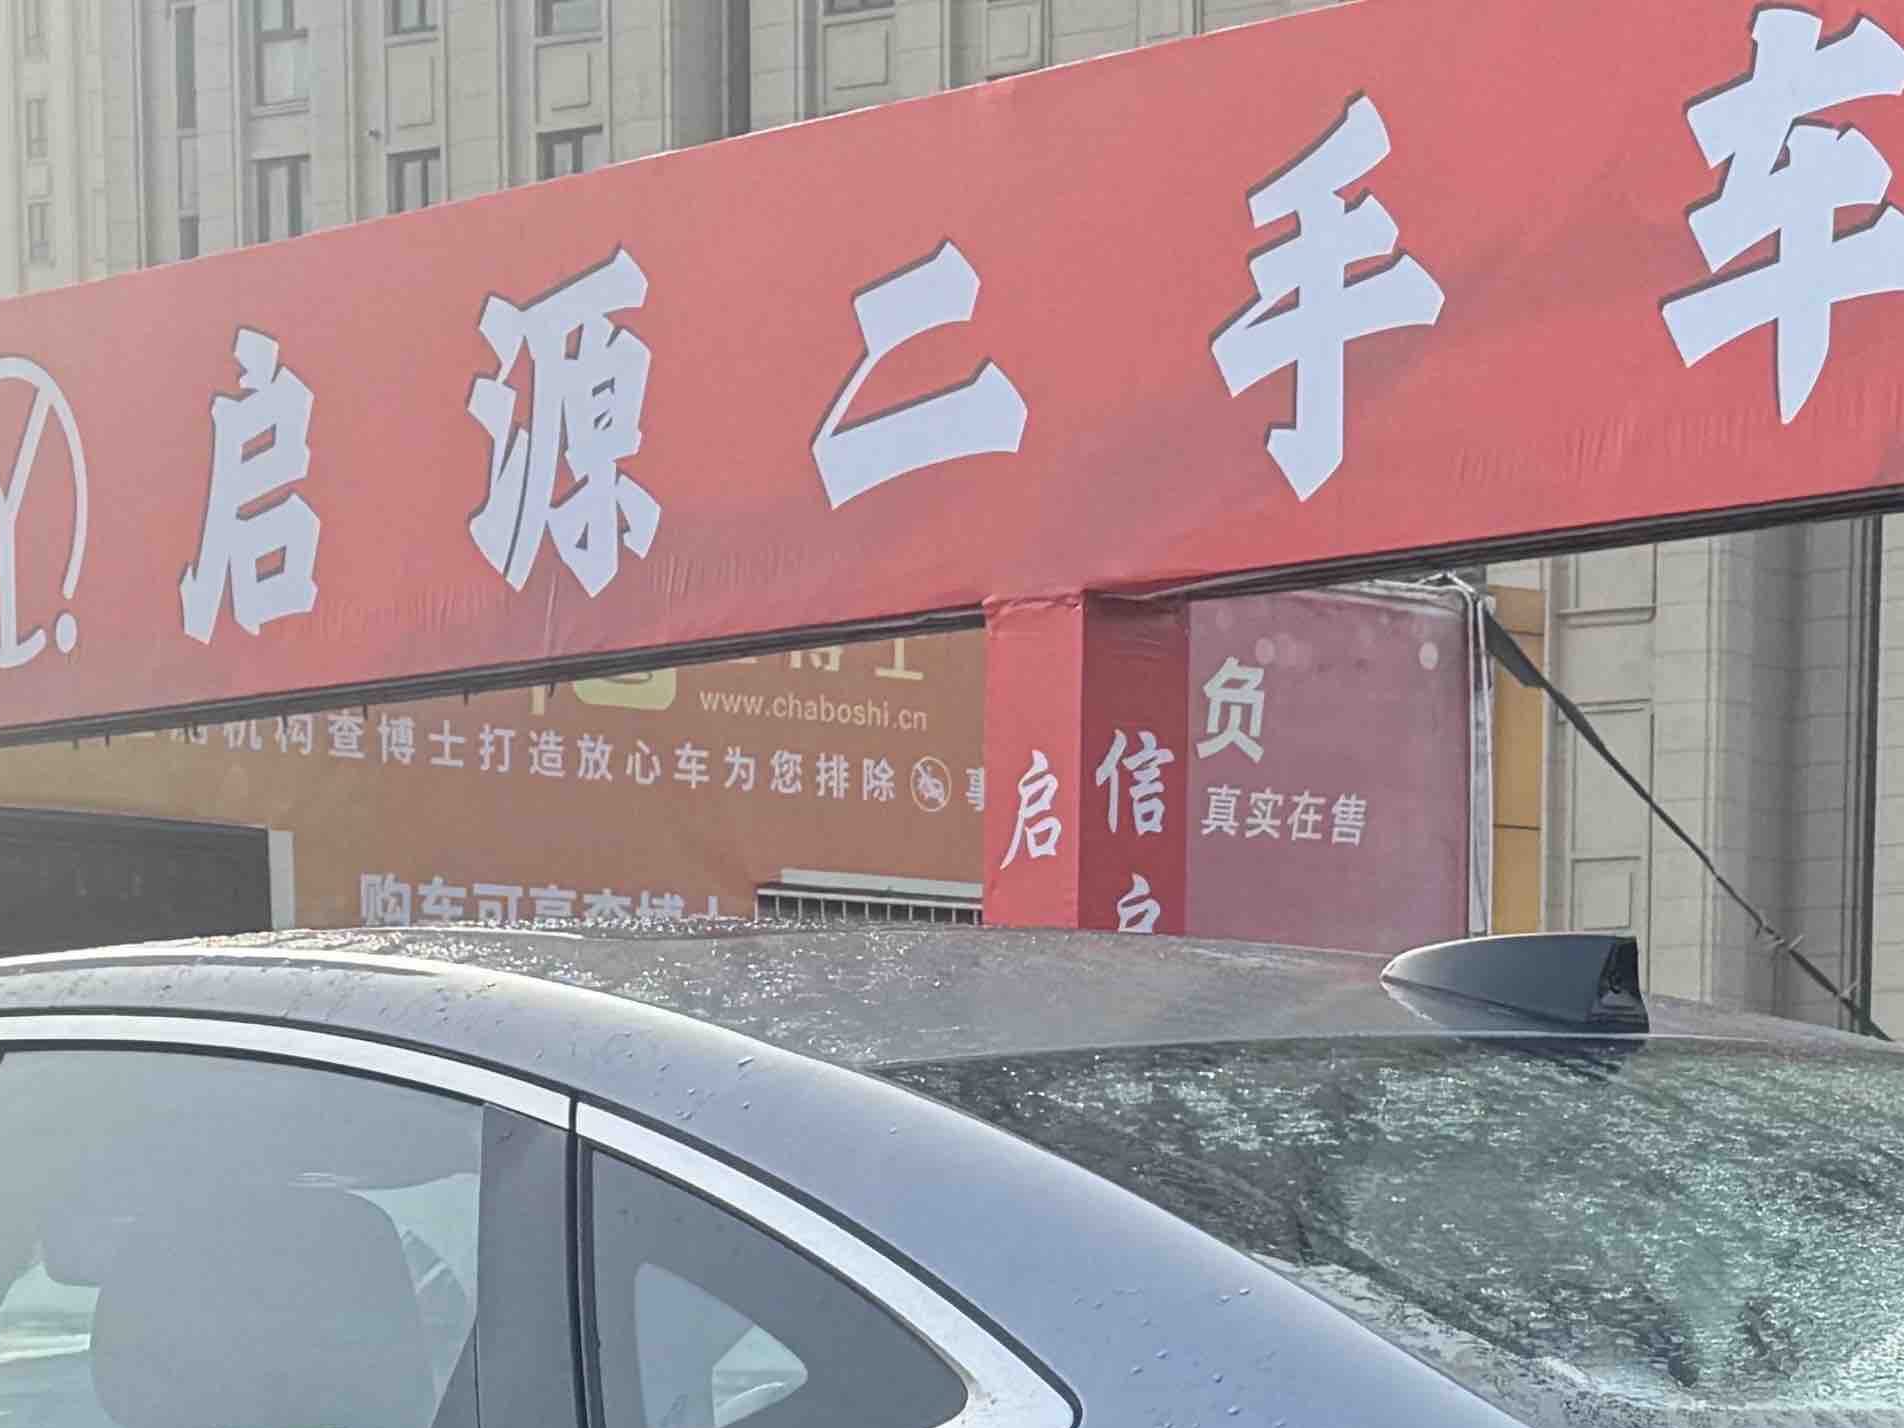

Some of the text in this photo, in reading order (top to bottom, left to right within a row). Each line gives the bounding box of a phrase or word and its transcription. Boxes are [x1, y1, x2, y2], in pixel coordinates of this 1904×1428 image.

[698, 687, 929, 731] www.chaboshi.cn
[1195, 655, 1266, 764] 负
[999, 749, 1063, 871] 启
[1200, 783, 1369, 848] 真实在售
